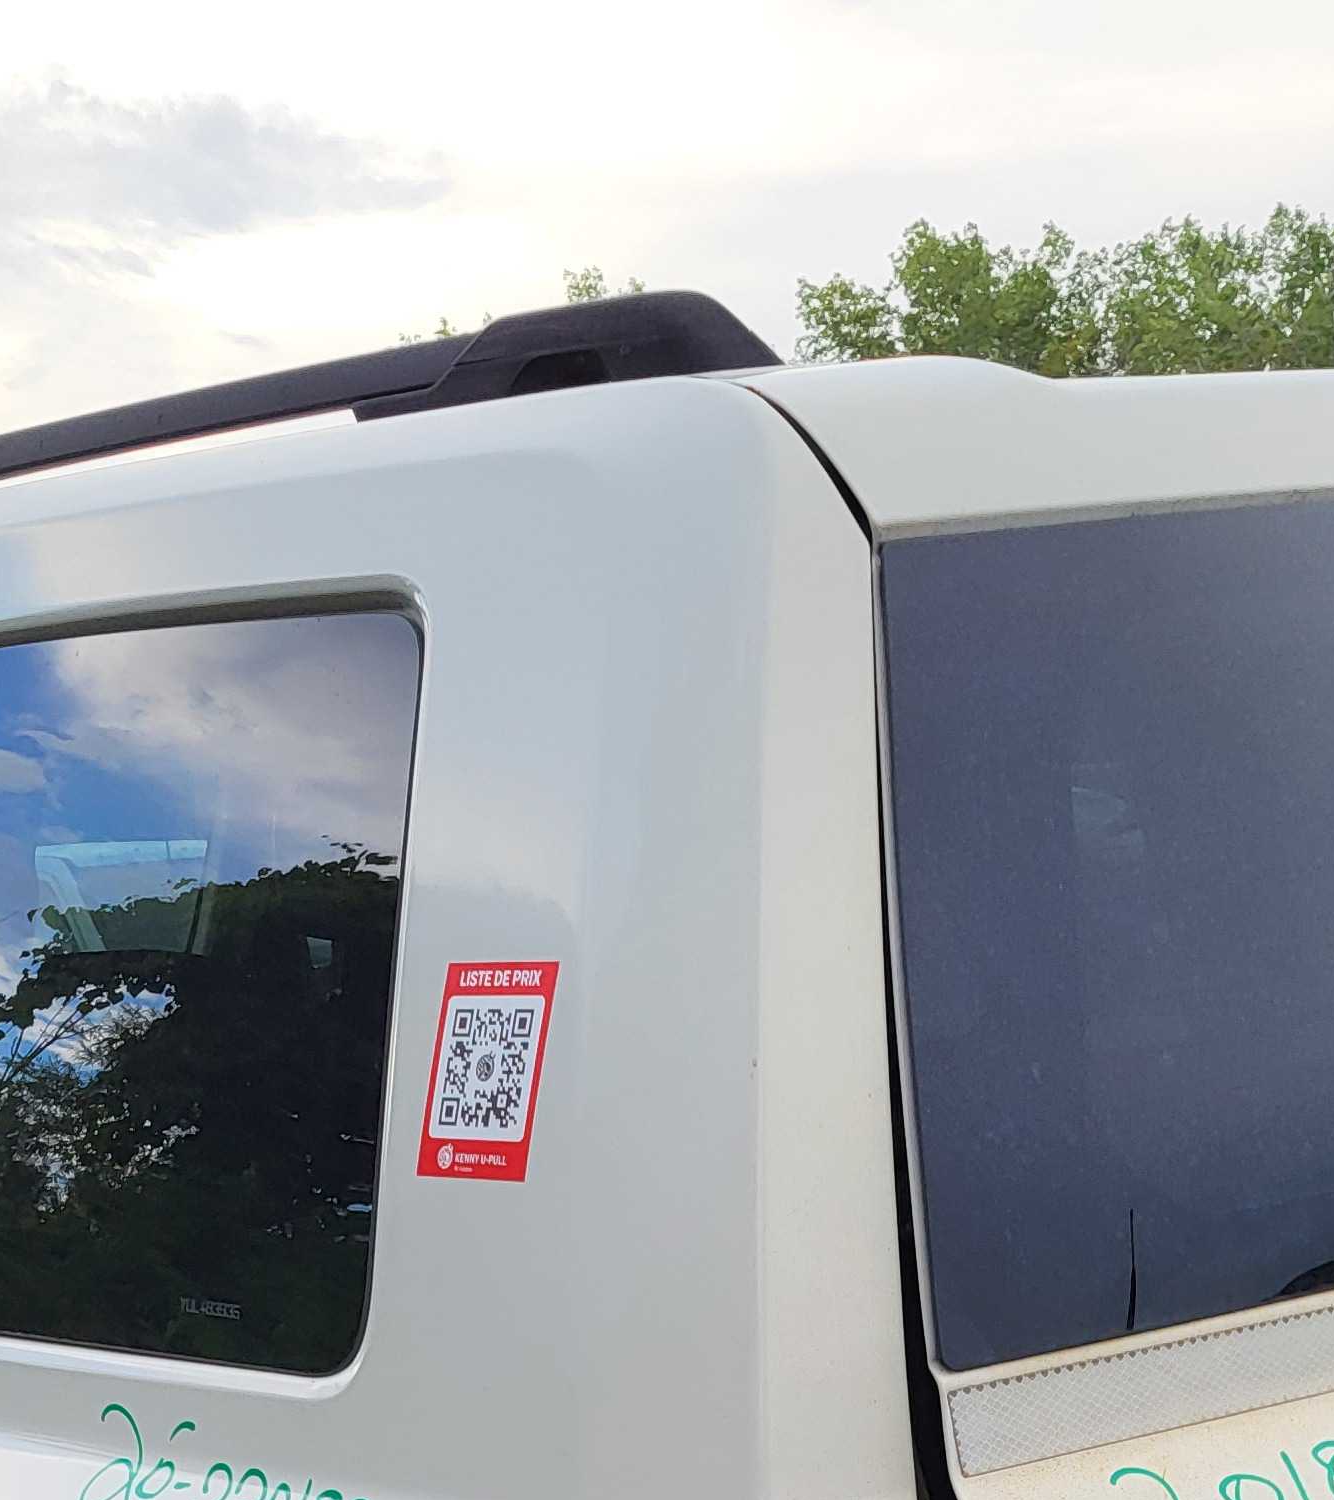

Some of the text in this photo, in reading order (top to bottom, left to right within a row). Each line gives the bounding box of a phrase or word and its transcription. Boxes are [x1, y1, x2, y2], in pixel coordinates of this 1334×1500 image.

[459, 968, 543, 988] LISTE DE PRIX
[454, 1152, 480, 1165] KENNY
